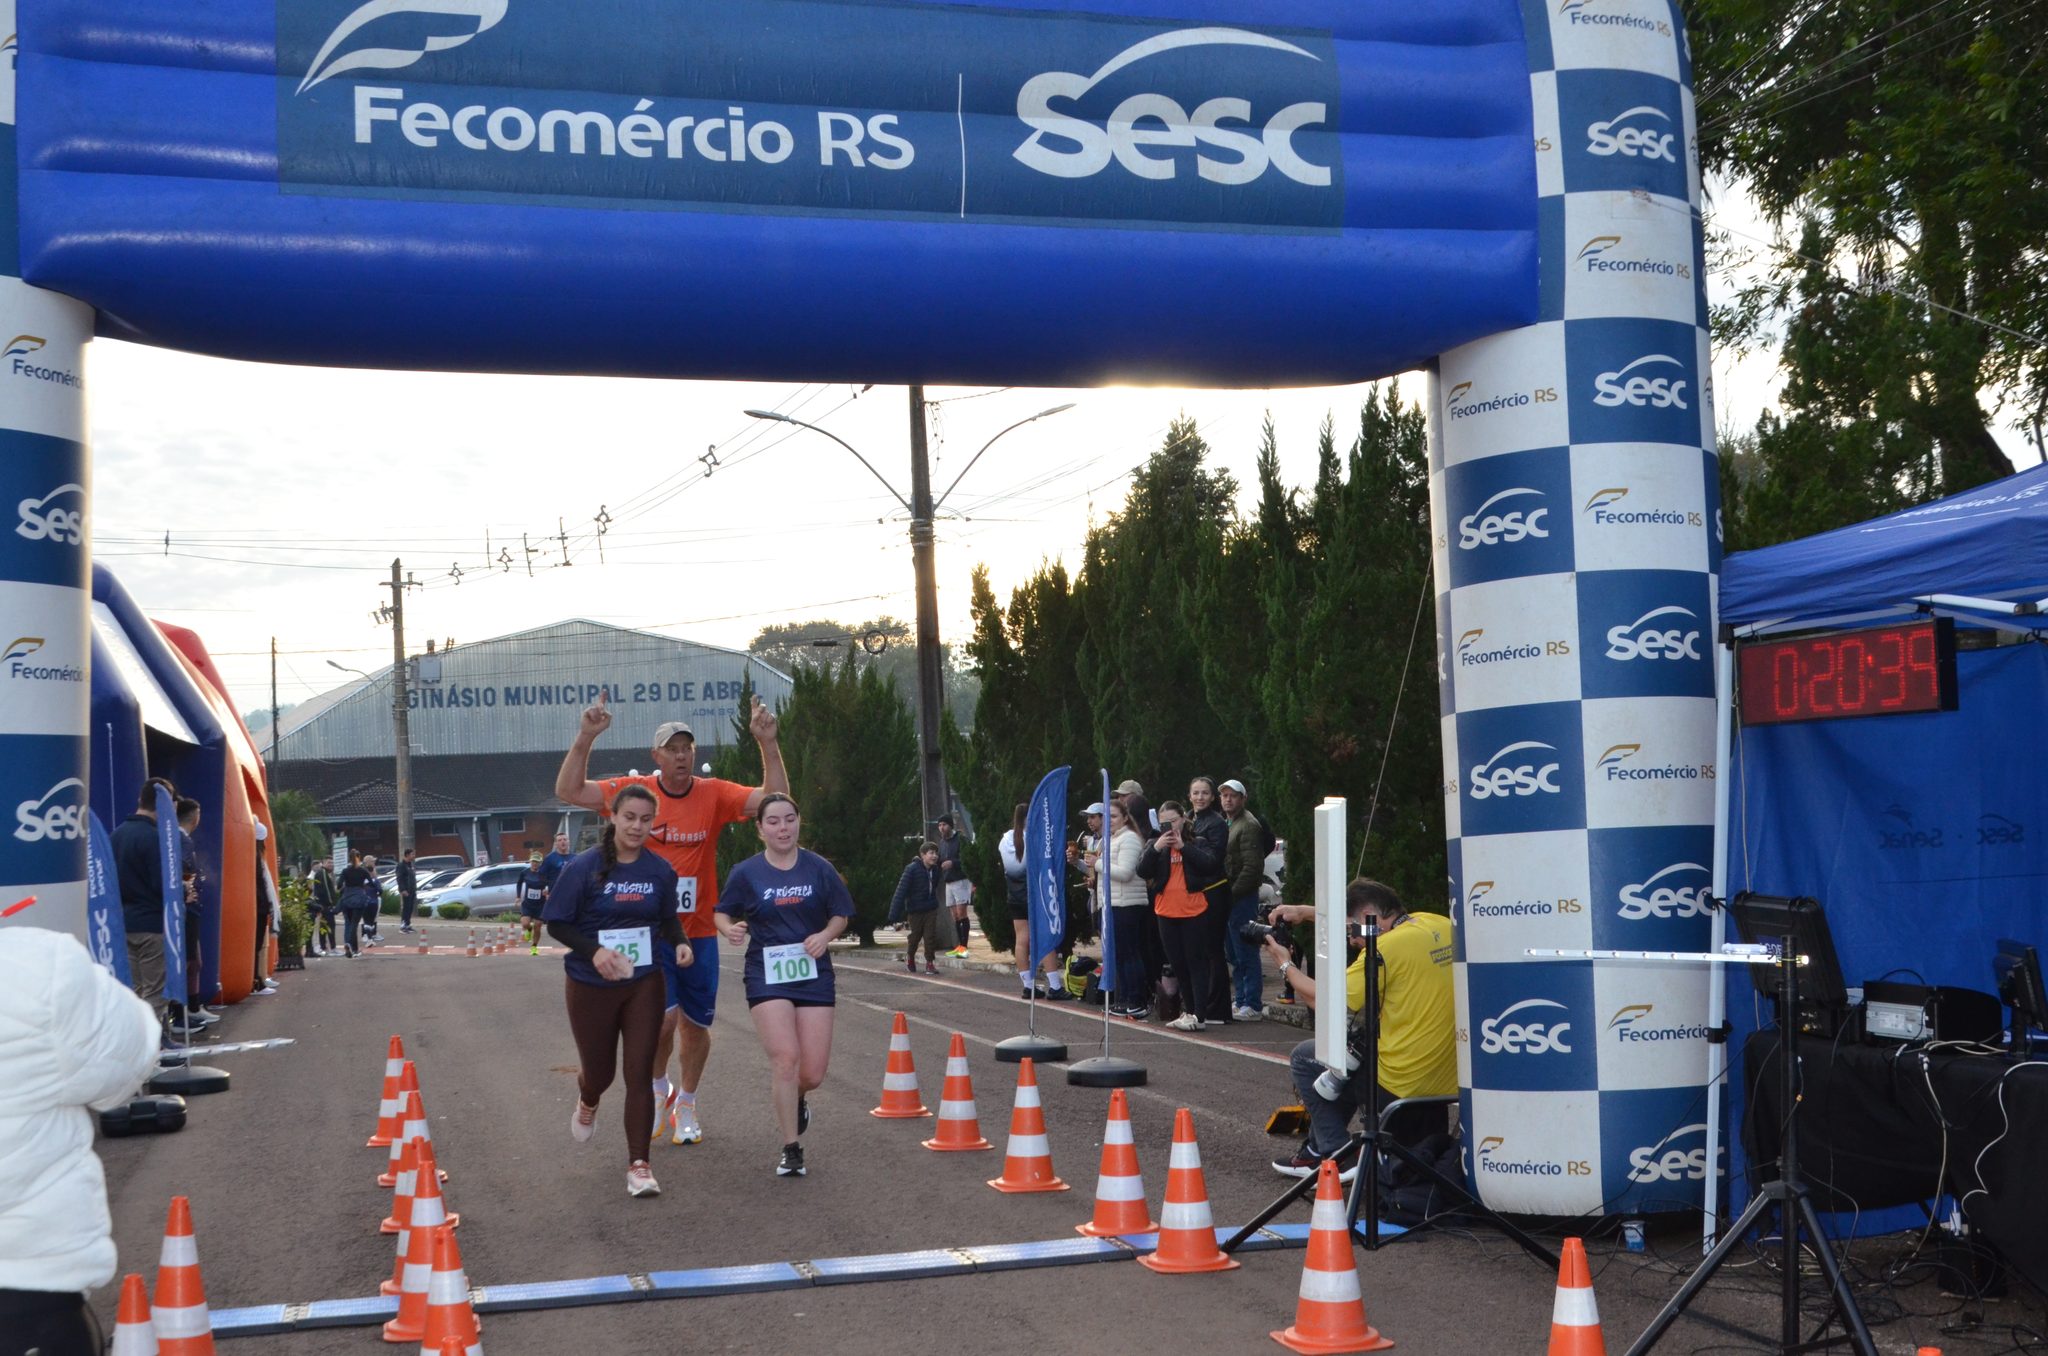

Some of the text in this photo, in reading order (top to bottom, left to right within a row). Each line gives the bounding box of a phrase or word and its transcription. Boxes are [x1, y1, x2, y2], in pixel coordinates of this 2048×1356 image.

[1571, 11, 1672, 37] Fecomércio RS
[1012, 26, 1331, 187] Sesc
[354, 85, 915, 170] Fecomércio RS
[1586, 106, 1676, 163] Sesc
[1588, 258, 1690, 280] Fecomércio RS
[1593, 354, 1688, 410] Sesc
[1450, 387, 1558, 422] Fecomércio RS
[1458, 487, 1549, 550] Sesc
[1595, 509, 1685, 526] Fecomércio
[1688, 511, 1702, 527] RS
[1605, 605, 1700, 661] Sesc
[1462, 644, 1541, 666] Fecomércio
[1546, 640, 1570, 656] RS
[407, 683, 497, 709] GINÁSIO
[634, 683, 662, 703] 29
[668, 682, 695, 701] DE
[703, 679, 764, 701] ABRL
[1470, 741, 1561, 800] Sesc
[1607, 764, 1716, 781] Fecomércio RS
[1472, 900, 1552, 917] Fecomércio
[1557, 898, 1582, 914] RS
[1617, 862, 1713, 920] Sesc
[773, 956, 811, 981] 100
[1480, 998, 1572, 1055] Sesc
[1482, 1156, 1562, 1176] Fecomércio
[1567, 1160, 1591, 1176] RS
